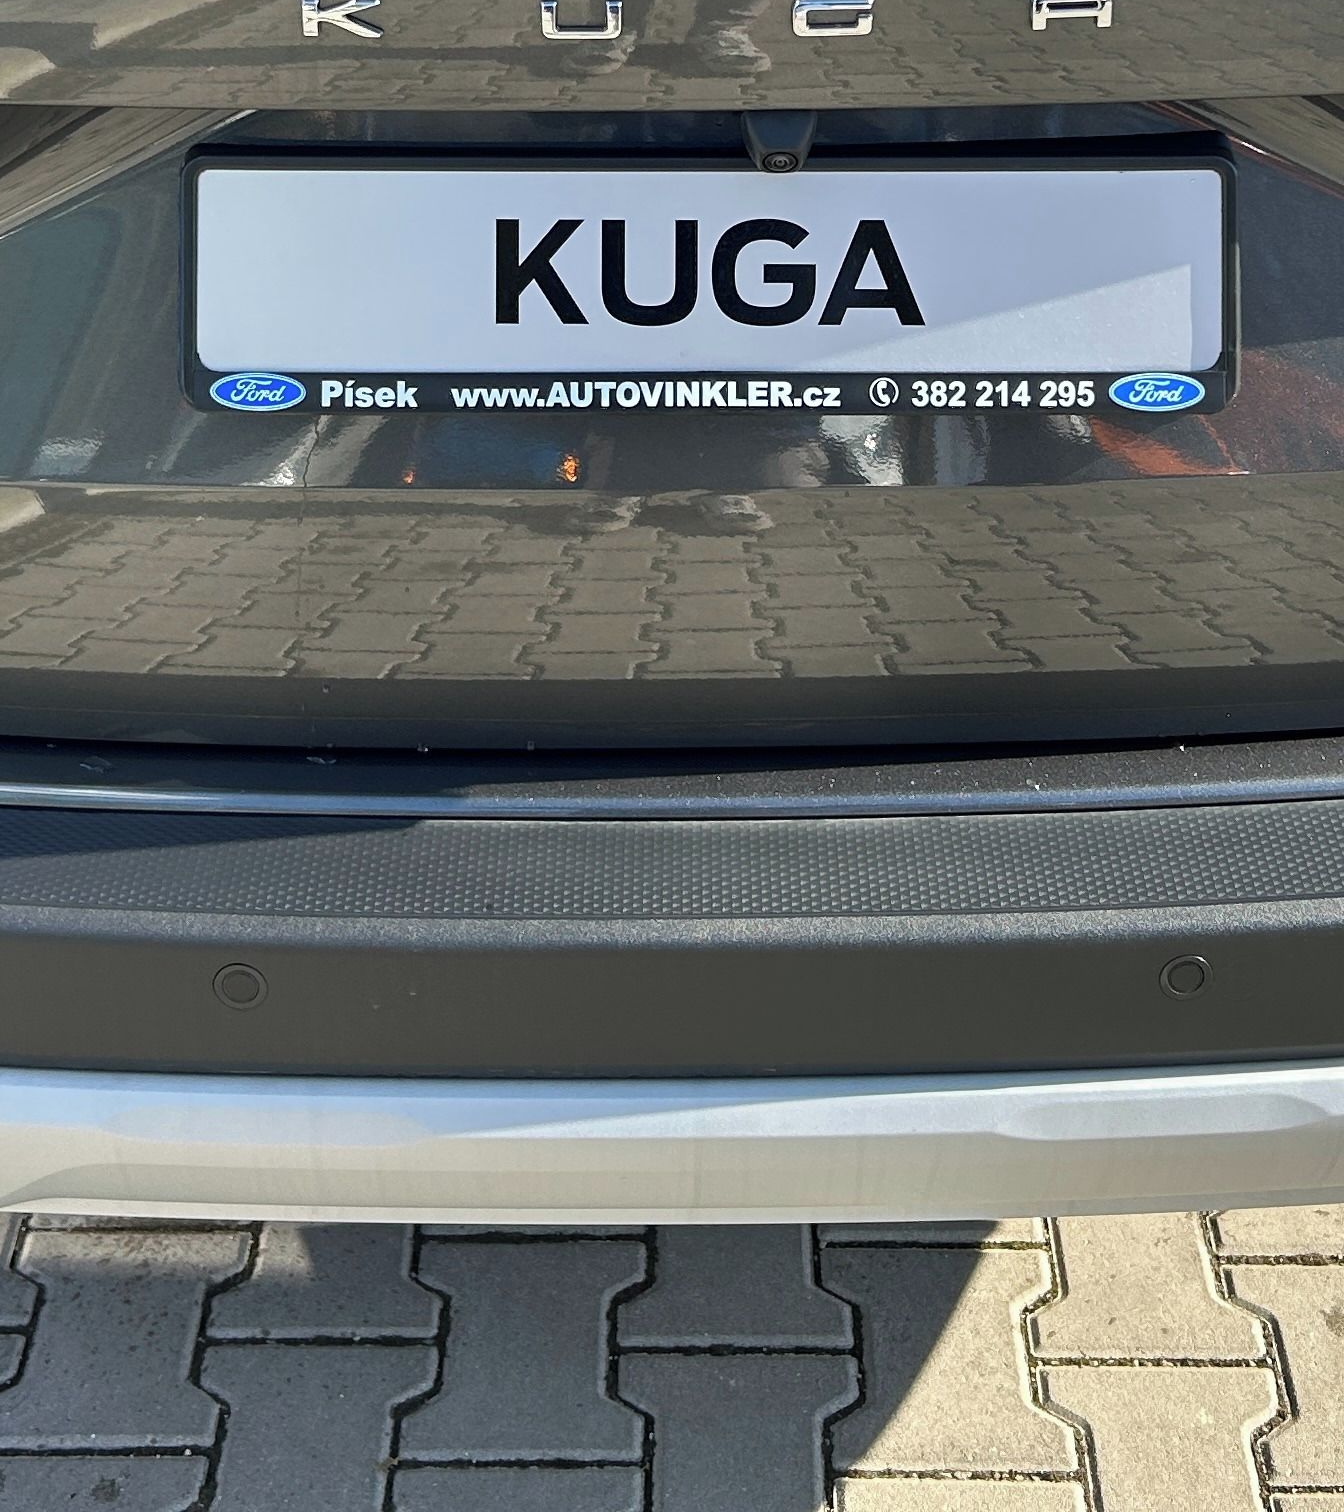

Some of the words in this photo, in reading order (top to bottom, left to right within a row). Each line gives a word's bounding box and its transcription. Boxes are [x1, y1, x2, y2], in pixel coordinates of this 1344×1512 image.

[494, 218, 926, 326] KUGA
[230, 378, 285, 404] Ford
[321, 380, 418, 408] Písek
[451, 381, 842, 408] www.AUTOVINKLER.cz
[911, 380, 966, 407] 382
[975, 380, 1031, 407] 214
[1039, 380, 1096, 407] 295
[1128, 378, 1183, 404] Ford
